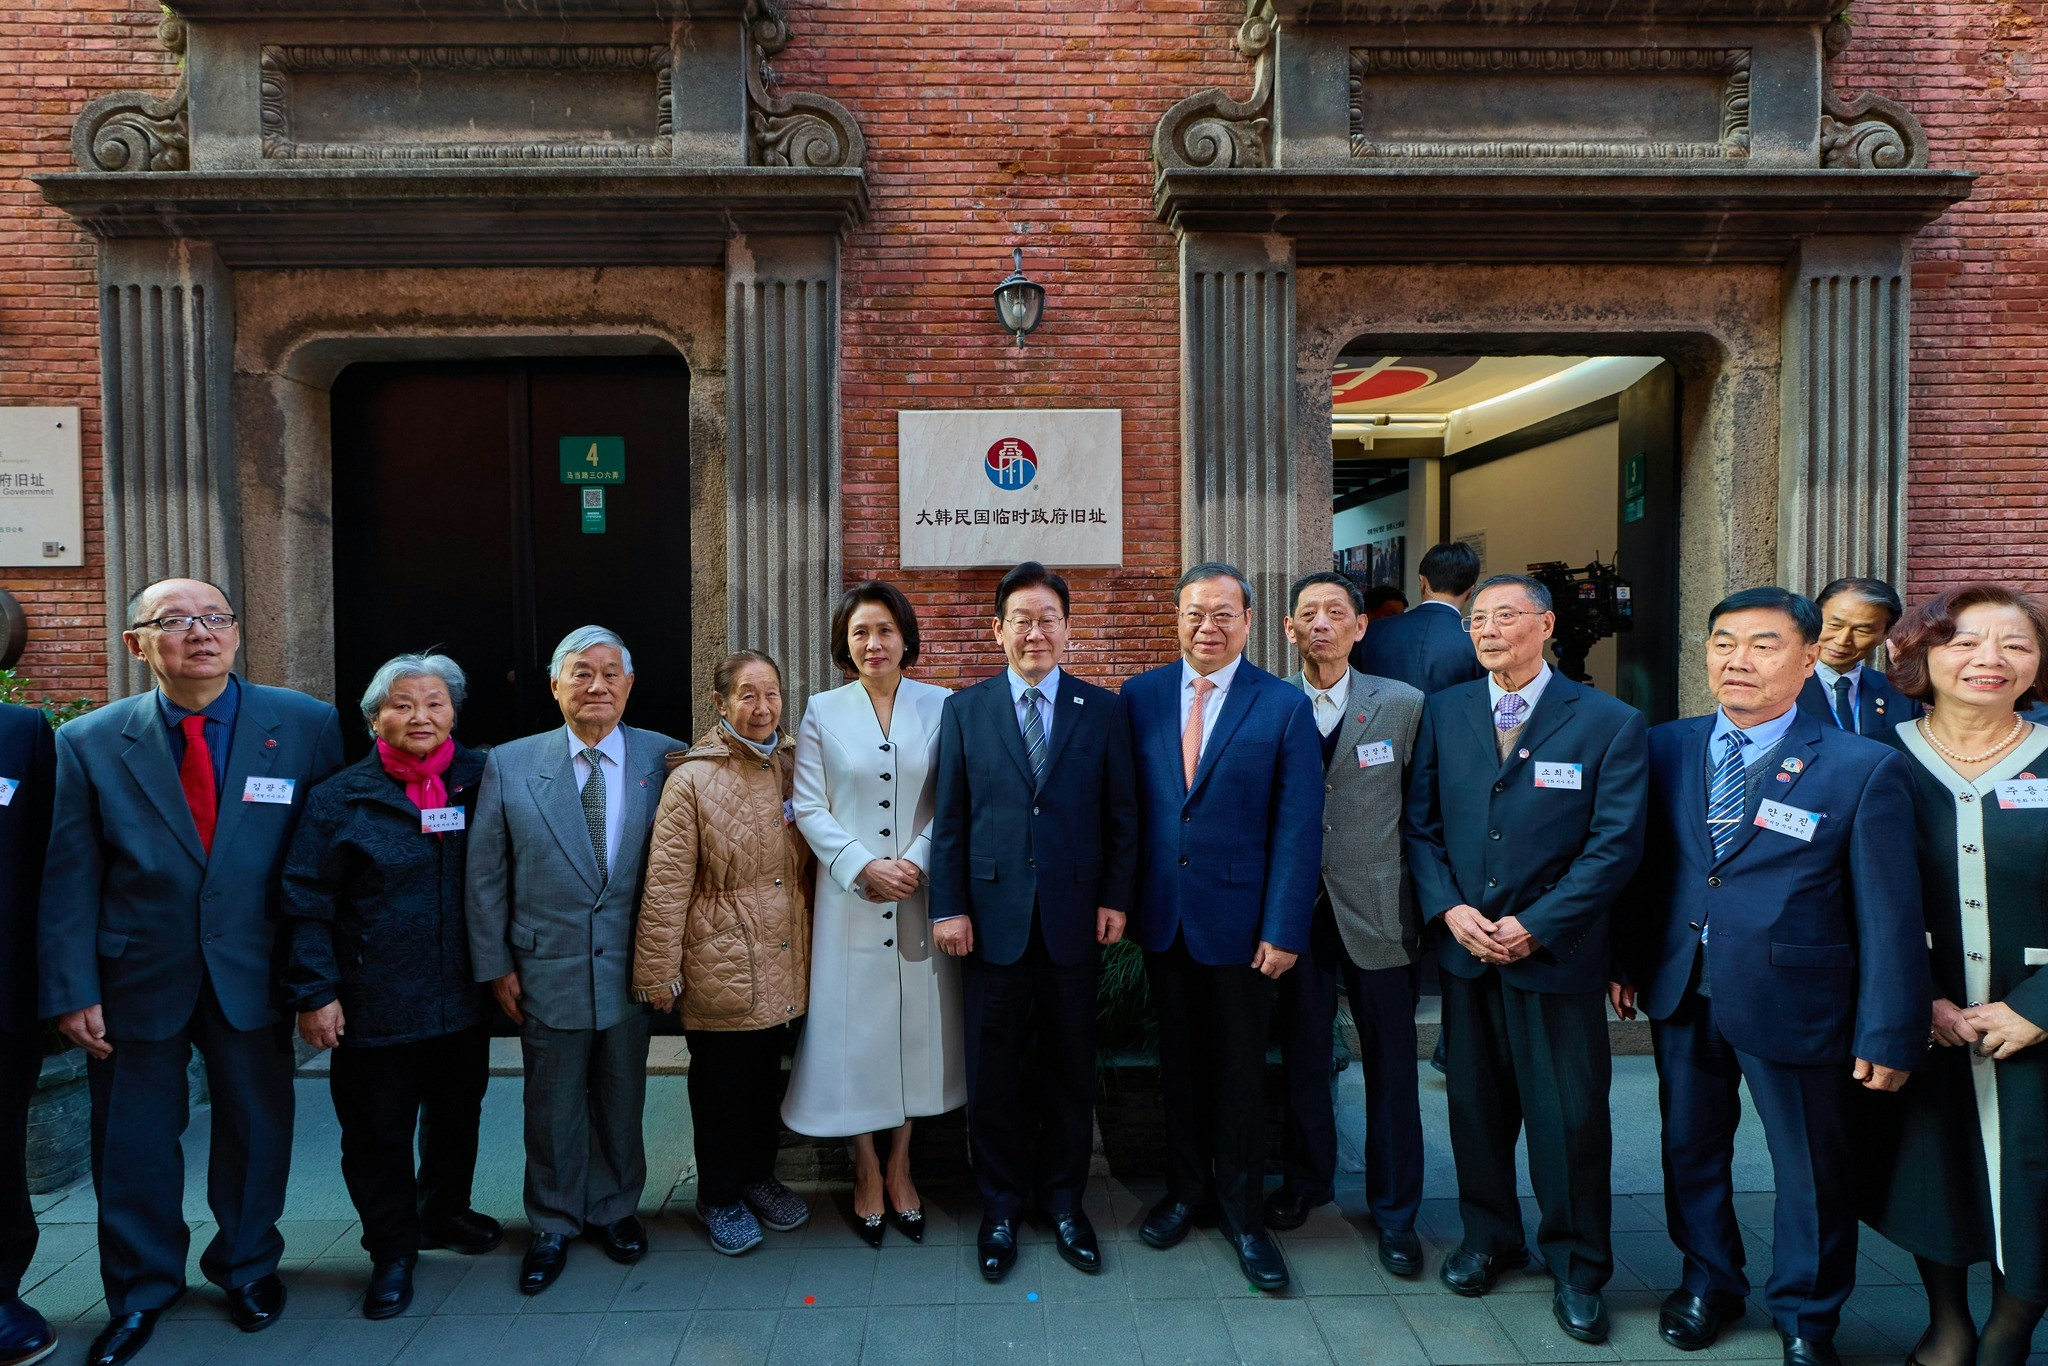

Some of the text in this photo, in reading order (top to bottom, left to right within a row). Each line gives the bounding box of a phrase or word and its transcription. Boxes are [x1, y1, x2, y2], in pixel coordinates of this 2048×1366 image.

[585, 442, 599, 467] 4
[2, 488, 54, 496] Government
[915, 507, 1108, 526] 大韩民国临时政府旧址
[2005, 785, 2048, 796] 주용
[1767, 807, 1809, 827] 안성진
